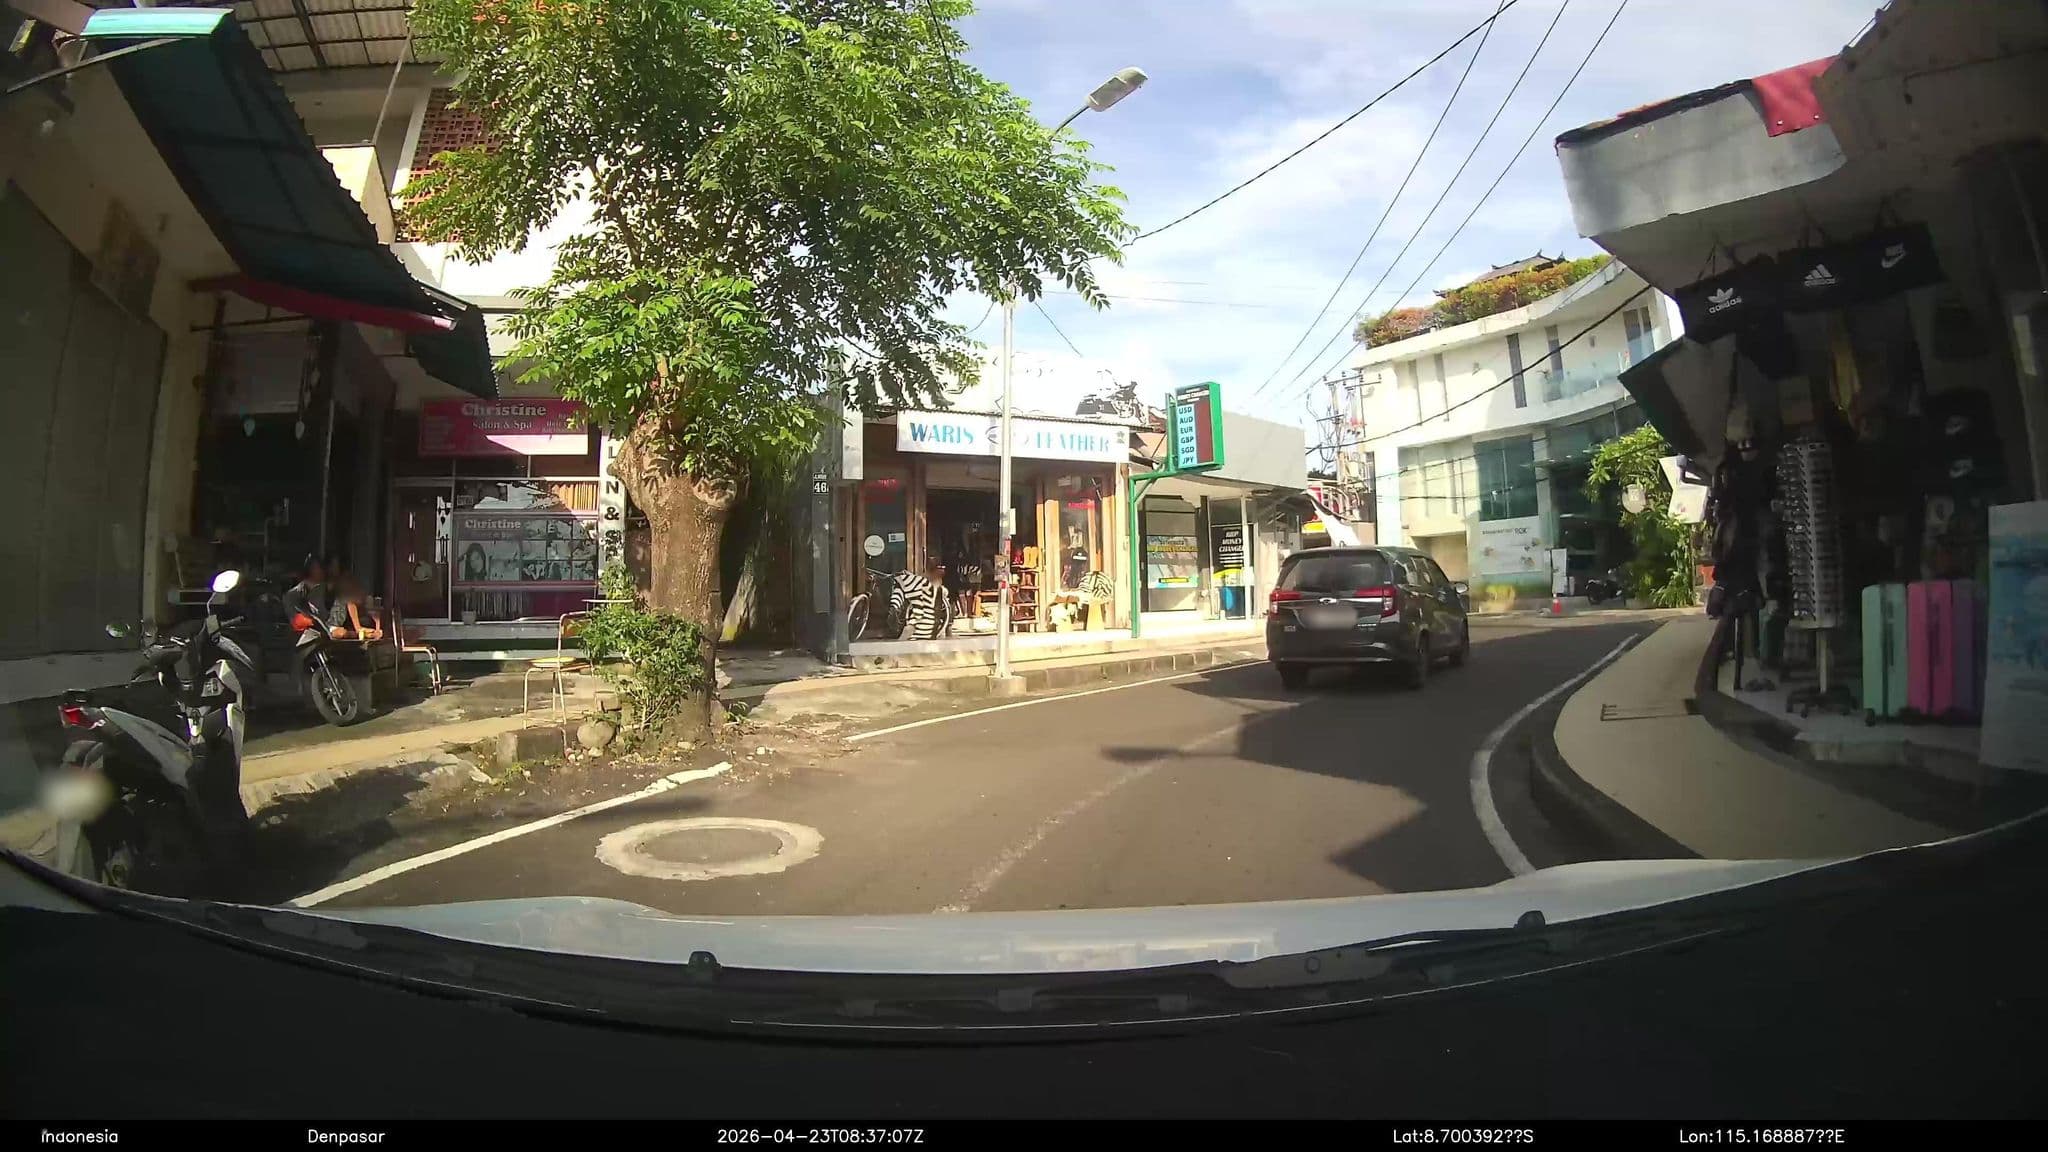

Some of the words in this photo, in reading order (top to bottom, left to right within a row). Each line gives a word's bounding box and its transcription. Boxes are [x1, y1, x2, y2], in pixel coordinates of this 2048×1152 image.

[1709, 297, 1743, 314] adidas
[461, 403, 547, 416] Christine
[1179, 406, 1192, 414] USD
[473, 420, 502, 429] Salon
[514, 420, 532, 431] Spa
[910, 422, 974, 444] WARIS
[1181, 436, 1194, 444] GBP
[1182, 446, 1195, 454] SGD
[1182, 456, 1194, 465] JPY
[813, 482, 829, 493] 46
[465, 519, 520, 529] Christine
